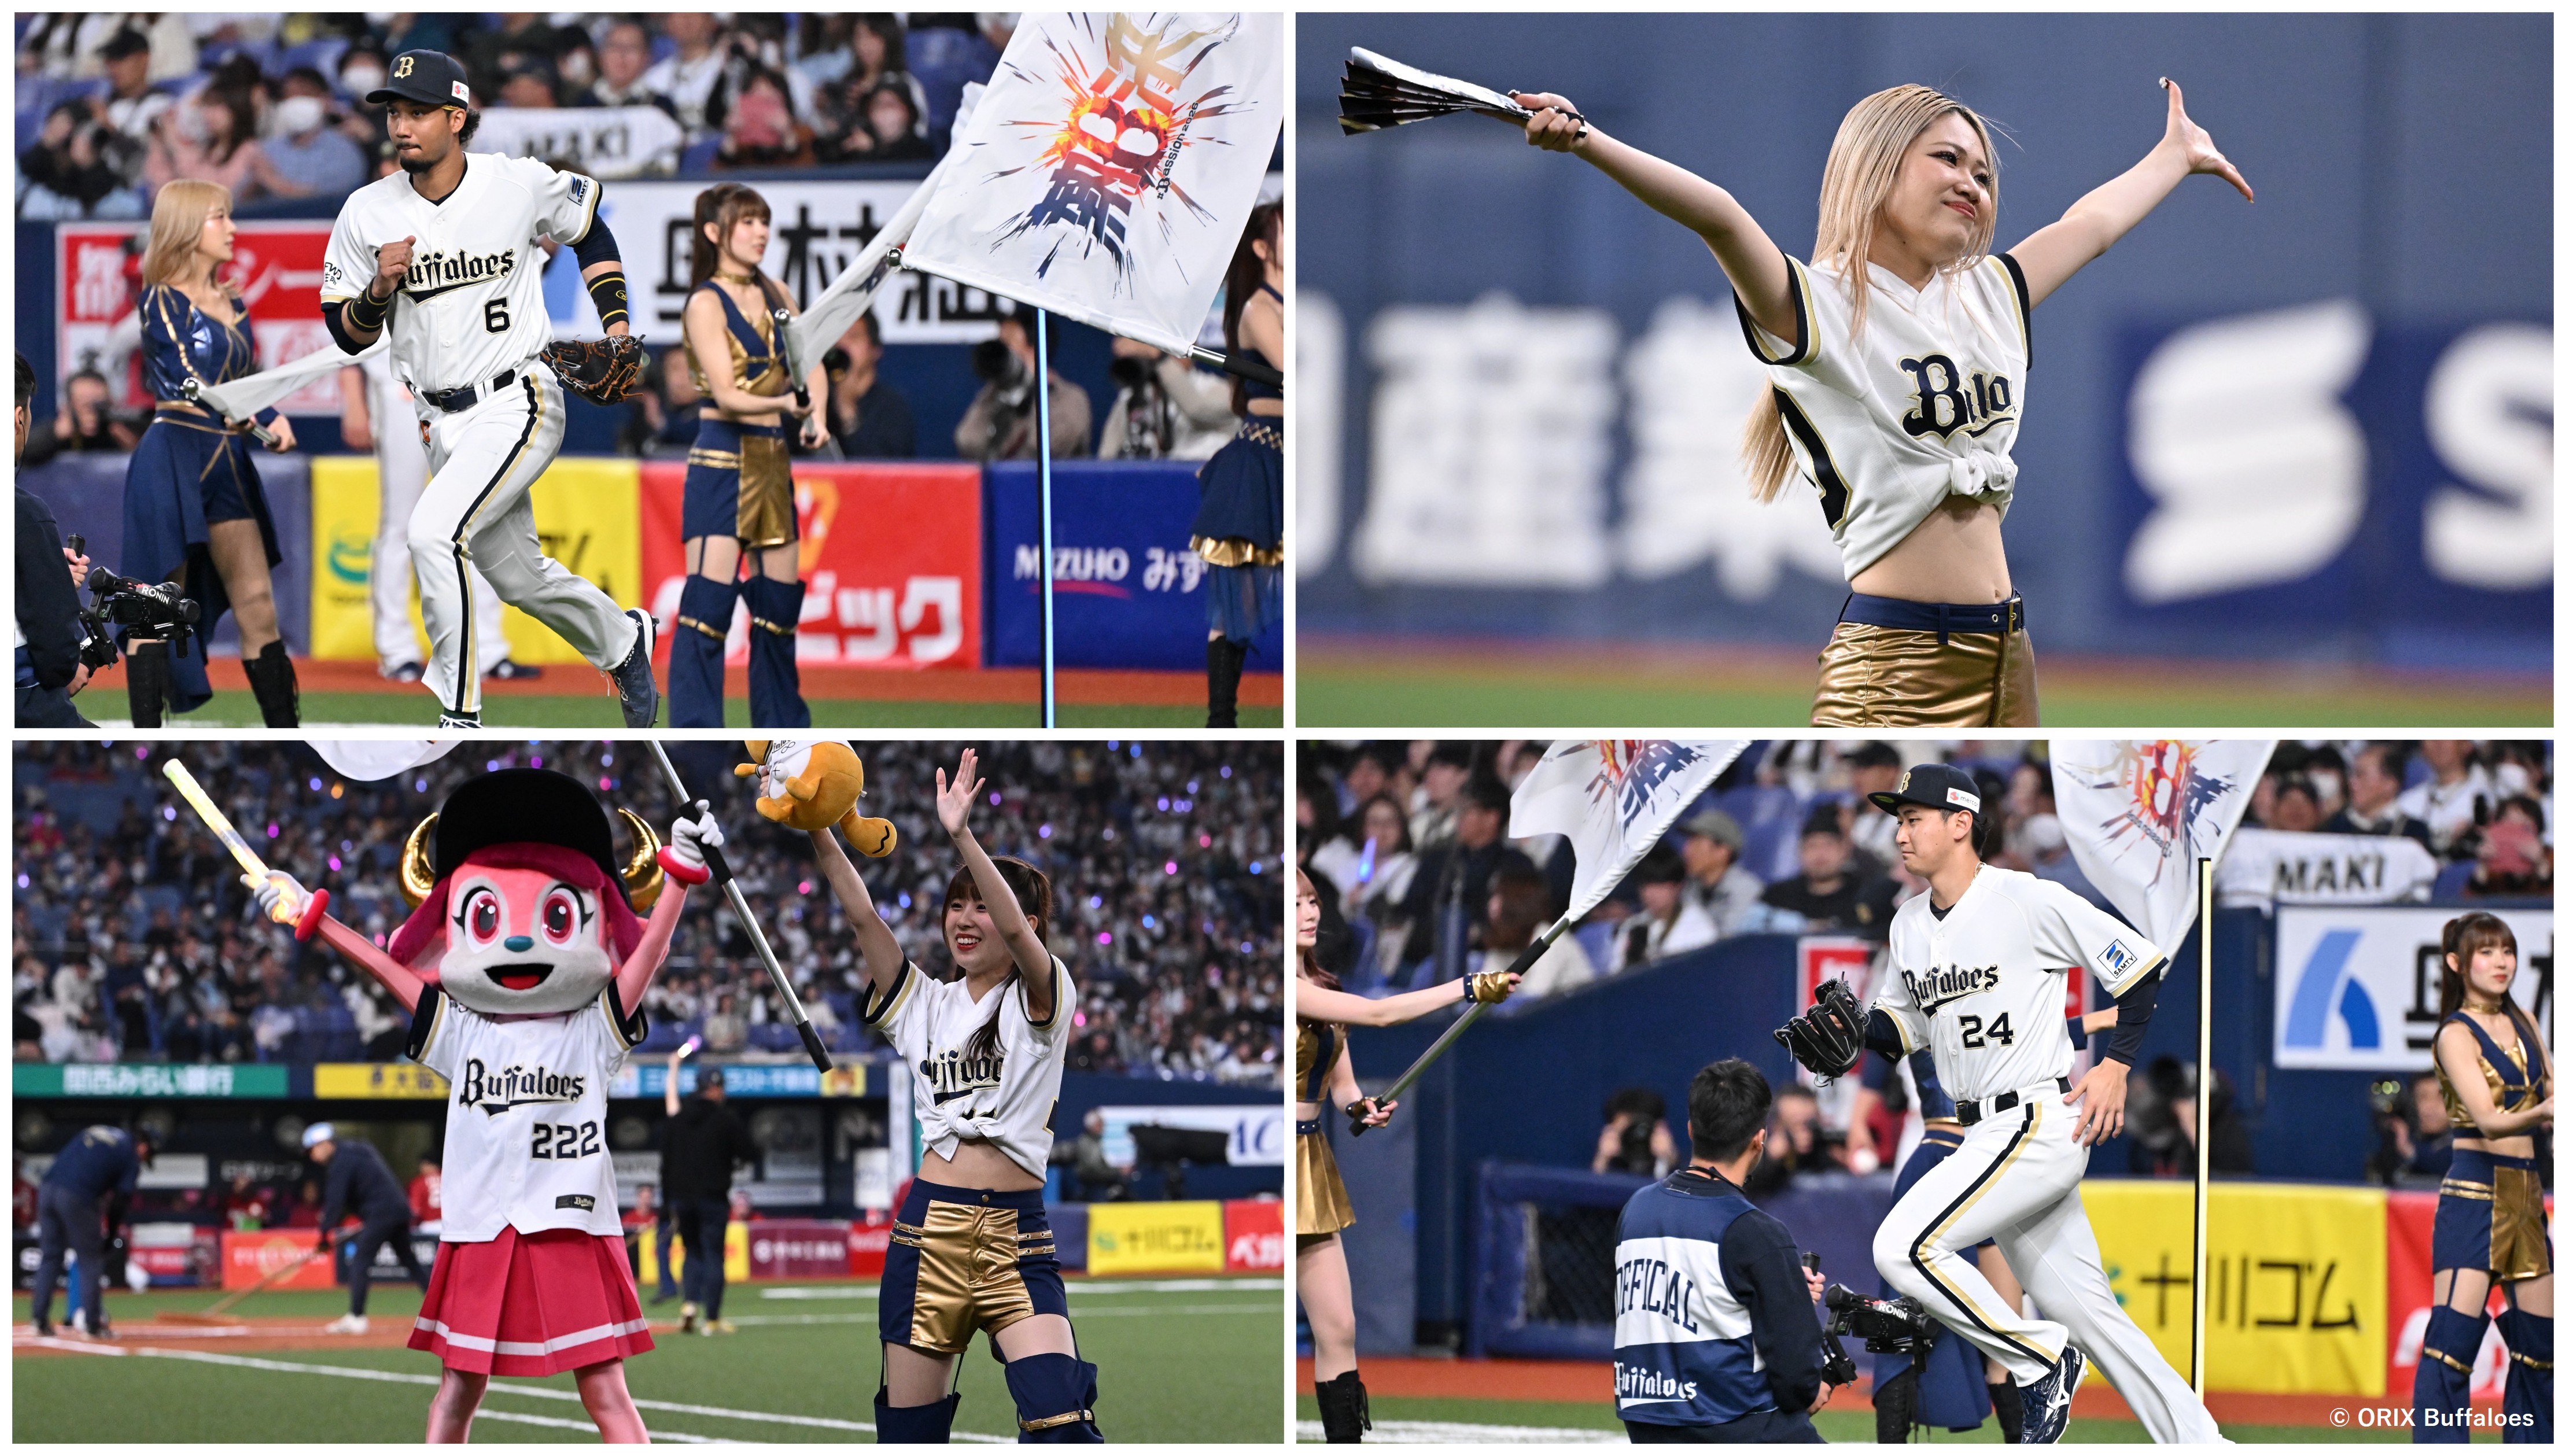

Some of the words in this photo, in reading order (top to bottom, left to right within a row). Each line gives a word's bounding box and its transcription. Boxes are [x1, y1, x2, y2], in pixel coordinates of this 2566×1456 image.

[394, 56, 415, 79] B
[577, 178, 588, 204] SAMTY
[375, 248, 517, 296] uffaloes
[484, 296, 513, 335] 6
[1013, 544, 1130, 582] MZUHO
[1141, 546, 1208, 593] みず
[141, 585, 170, 605] RONIN
[2276, 853, 2387, 892] MAKI
[2114, 955, 2134, 976] SAMTY
[1957, 1011, 2015, 1050] 24
[458, 1057, 587, 1114] Buffaloes
[531, 1121, 600, 1160] 222
[1878, 1302, 1908, 1321] RONIN
[2139, 1252, 2365, 1332] 十川ゴム
